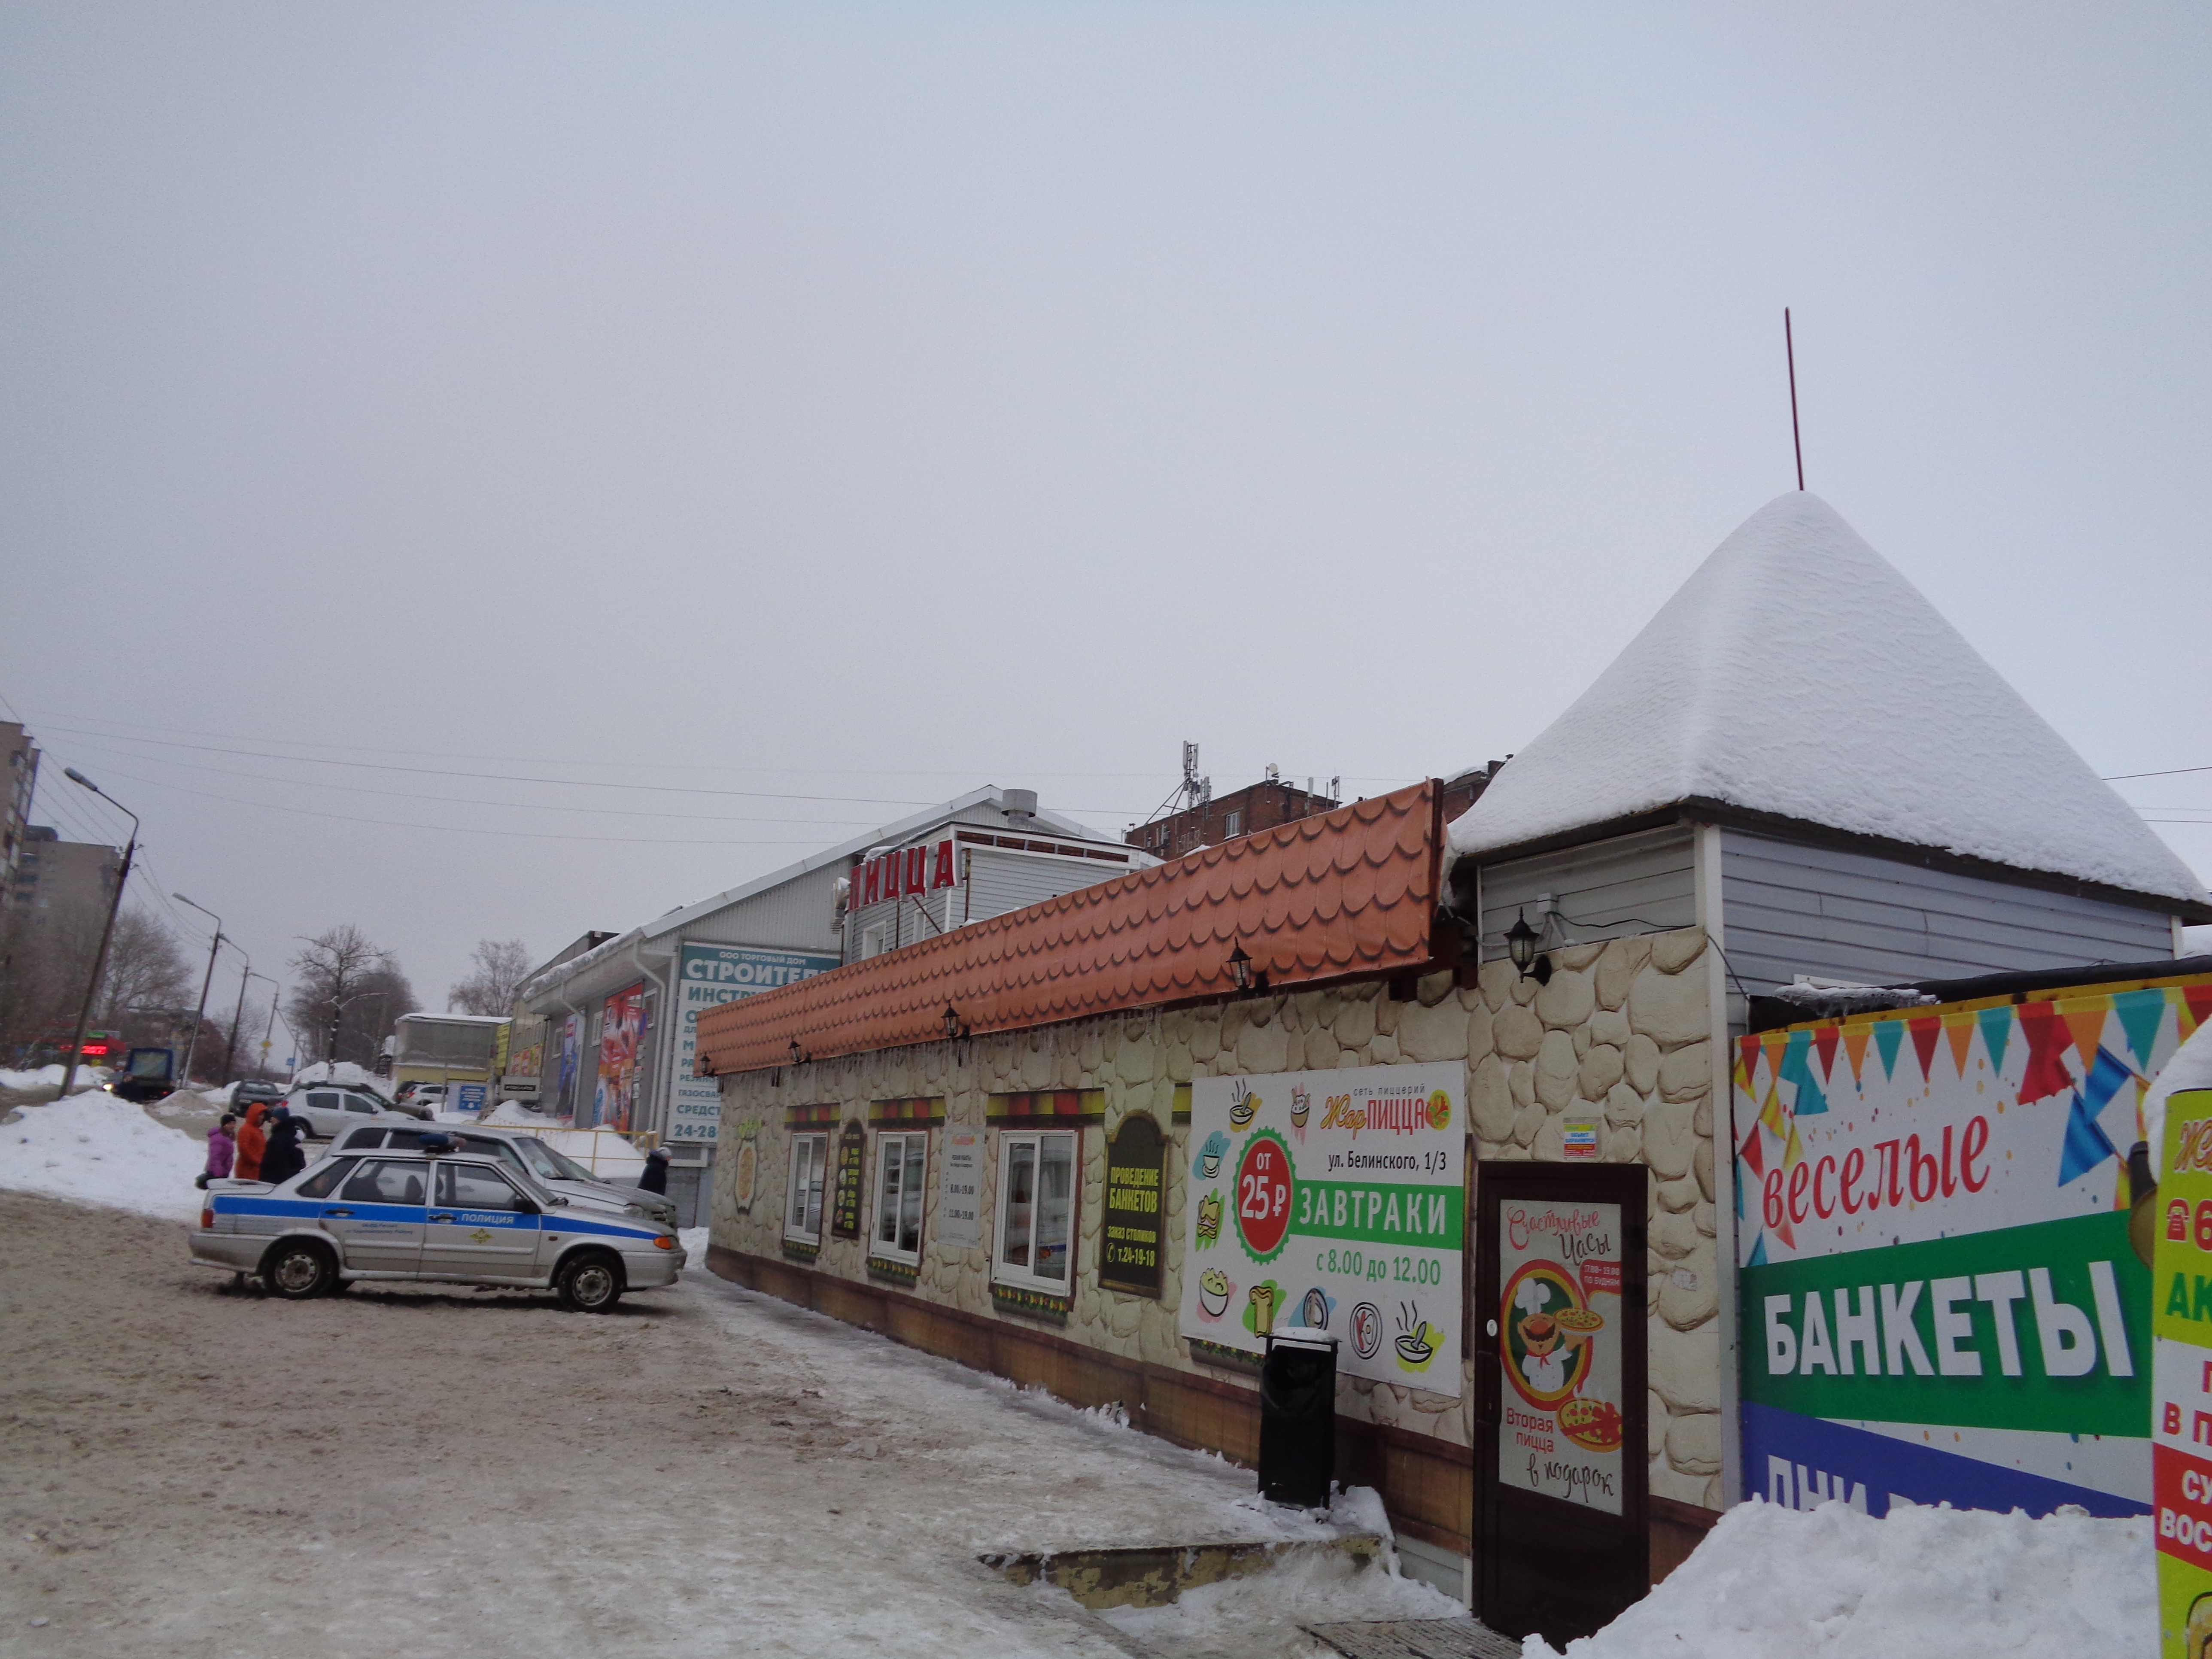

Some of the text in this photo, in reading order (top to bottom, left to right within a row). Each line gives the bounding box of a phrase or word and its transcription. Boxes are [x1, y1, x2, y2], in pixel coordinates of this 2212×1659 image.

[848, 839, 957, 912] ПИЦЦА
[720, 951, 739, 960] ООО
[741, 953, 786, 963] ТОРГОВЫЙ
[687, 958, 827, 985] СТРОИТЕ
[1353, 1083, 1425, 1097] сеть пиццерий
[1328, 1150, 1446, 1175] ул. Белинского, 1/3
[1762, 1115, 1990, 1229] веселые
[1110, 1167, 1159, 1188] ПРОВЕДЕНИЕ
[1109, 1188, 1158, 1212] БАНКЕТОВ
[1299, 1187, 1446, 1235] ЗАВТРАКИ
[462, 1213, 514, 1224] ПОЛИЦИЯ
[1507, 1206, 1600, 1251] Счастливые
[1559, 1233, 1611, 1266] Часы
[1316, 1249, 1441, 1285] с 8.00 до 12.00
[1763, 1260, 2134, 1376] БАНКЕТЫ
[1506, 1407, 1554, 1434] Вторая
[1516, 1432, 1554, 1454] пицца
[1544, 1461, 1614, 1503] подарок
